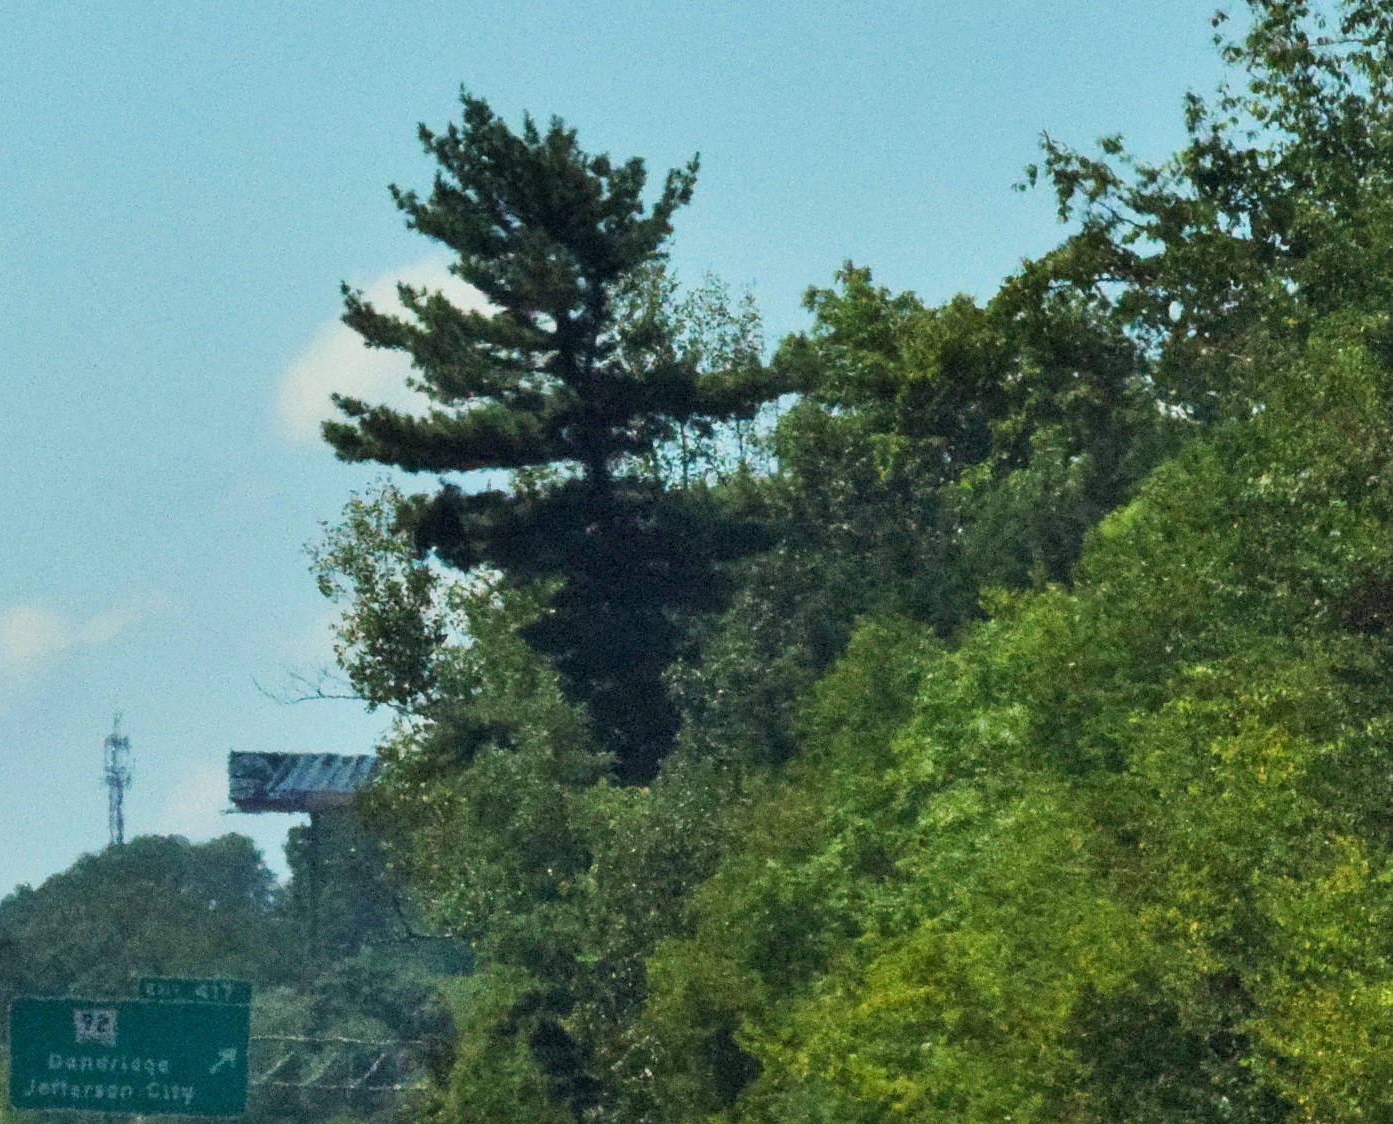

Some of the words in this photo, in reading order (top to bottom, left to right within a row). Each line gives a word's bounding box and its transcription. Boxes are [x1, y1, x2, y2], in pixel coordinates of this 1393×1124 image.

[81, 1012, 111, 1033] 92
[47, 1052, 170, 1077] Dandridge
[23, 1077, 134, 1100] Jefferson
[145, 1080, 196, 1106] City
